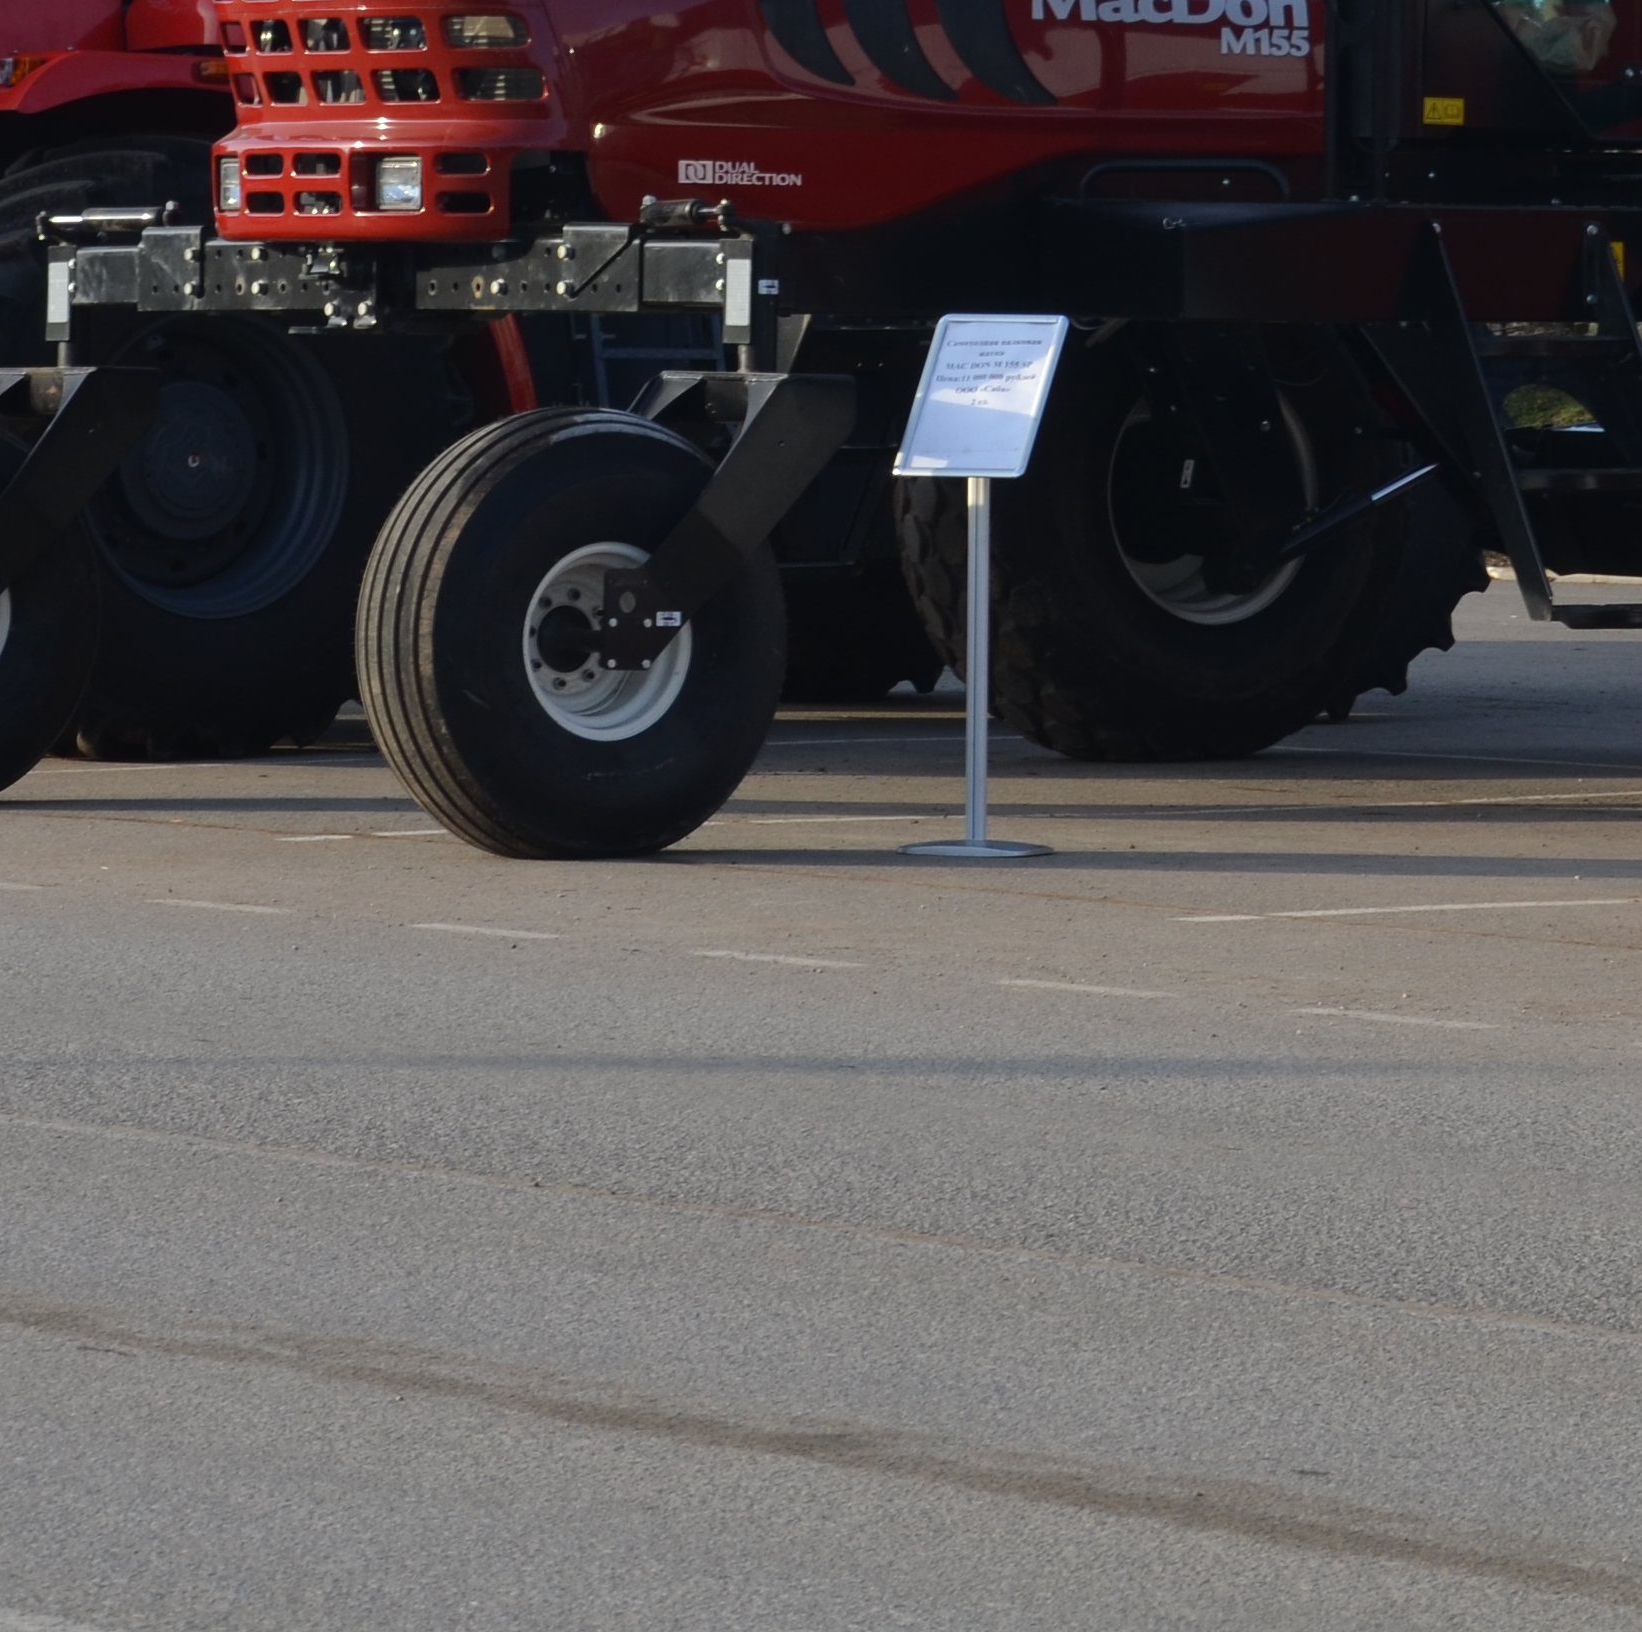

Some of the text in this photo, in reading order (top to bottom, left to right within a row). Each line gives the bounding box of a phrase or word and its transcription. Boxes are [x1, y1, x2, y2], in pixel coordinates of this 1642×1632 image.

[1220, 27, 1310, 57] M155
[715, 161, 759, 174] DUAL
[715, 172, 803, 187] DIRECTION
[945, 362, 967, 370] MAC
